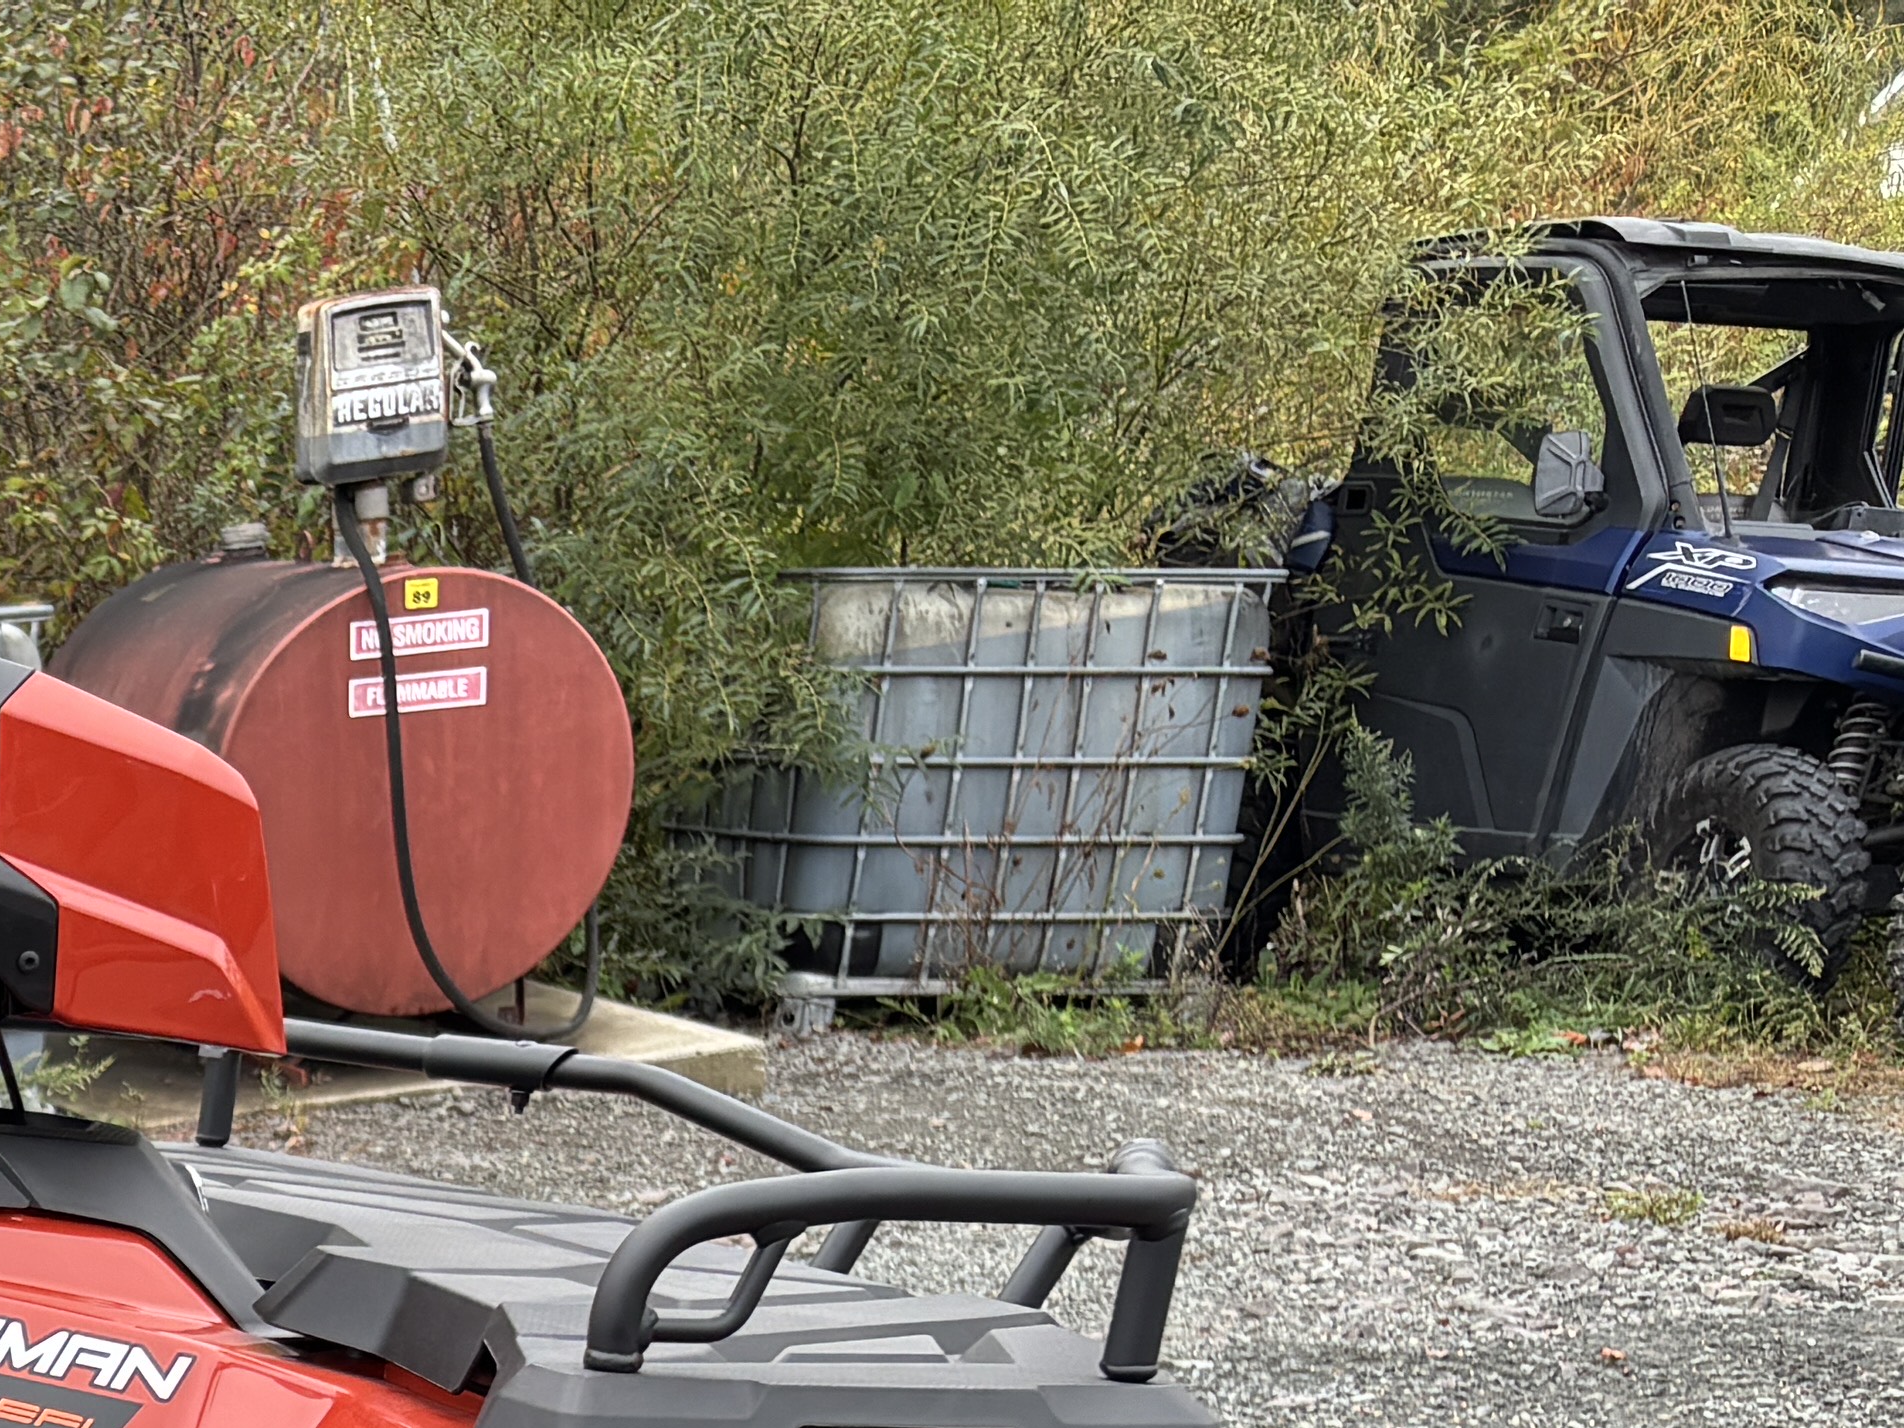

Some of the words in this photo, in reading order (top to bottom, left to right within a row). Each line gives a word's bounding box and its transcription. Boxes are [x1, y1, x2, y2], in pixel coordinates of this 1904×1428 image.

[333, 379, 442, 423] REGULAR
[1647, 541, 1756, 570] XP
[393, 617, 480, 647] SMOKING
[366, 678, 469, 707] FLMMABLE
